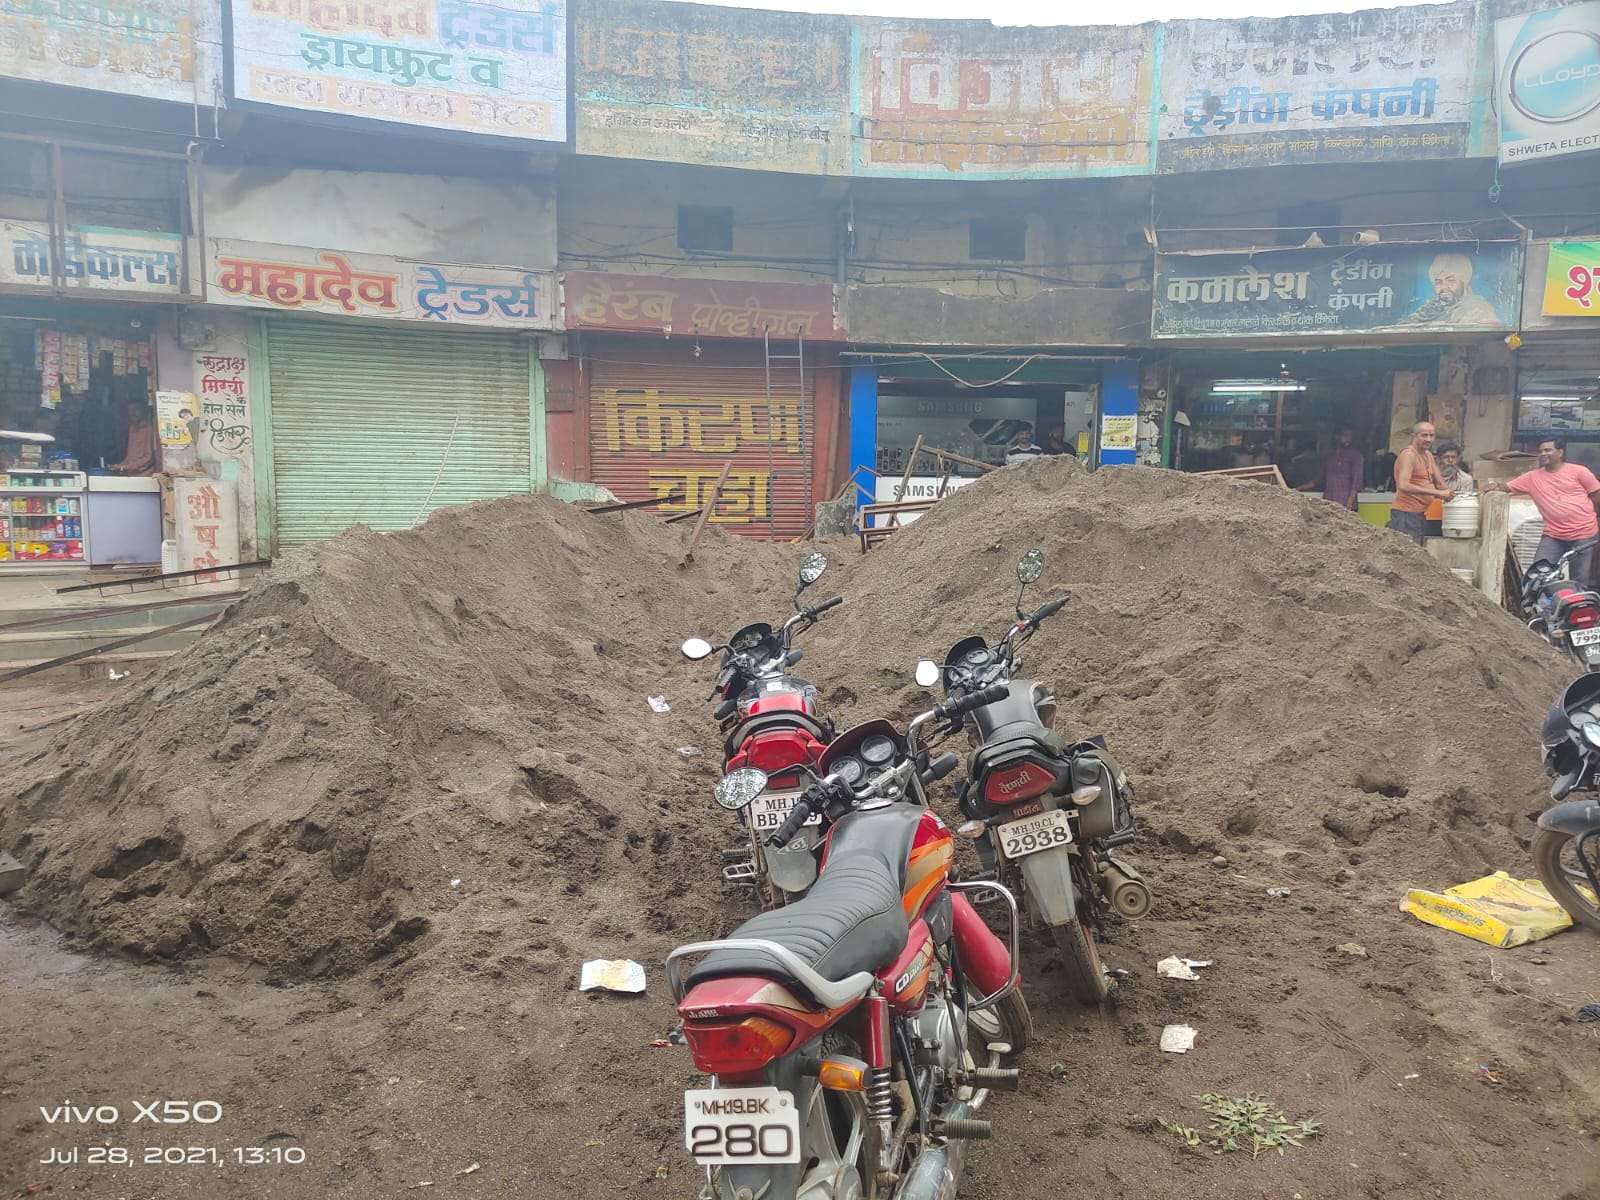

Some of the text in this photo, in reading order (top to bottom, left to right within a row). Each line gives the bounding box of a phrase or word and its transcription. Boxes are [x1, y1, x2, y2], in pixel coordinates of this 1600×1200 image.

[1312, 77, 1439, 120] कंपनी
[1508, 141, 1558, 157] SHWETA
[217, 252, 399, 311] महादेव
[1167, 266, 1311, 305] कमलेश
[1328, 286, 1395, 312] कंपनी
[1006, 826, 1068, 856] 2938
[691, 1124, 793, 1158] 280
